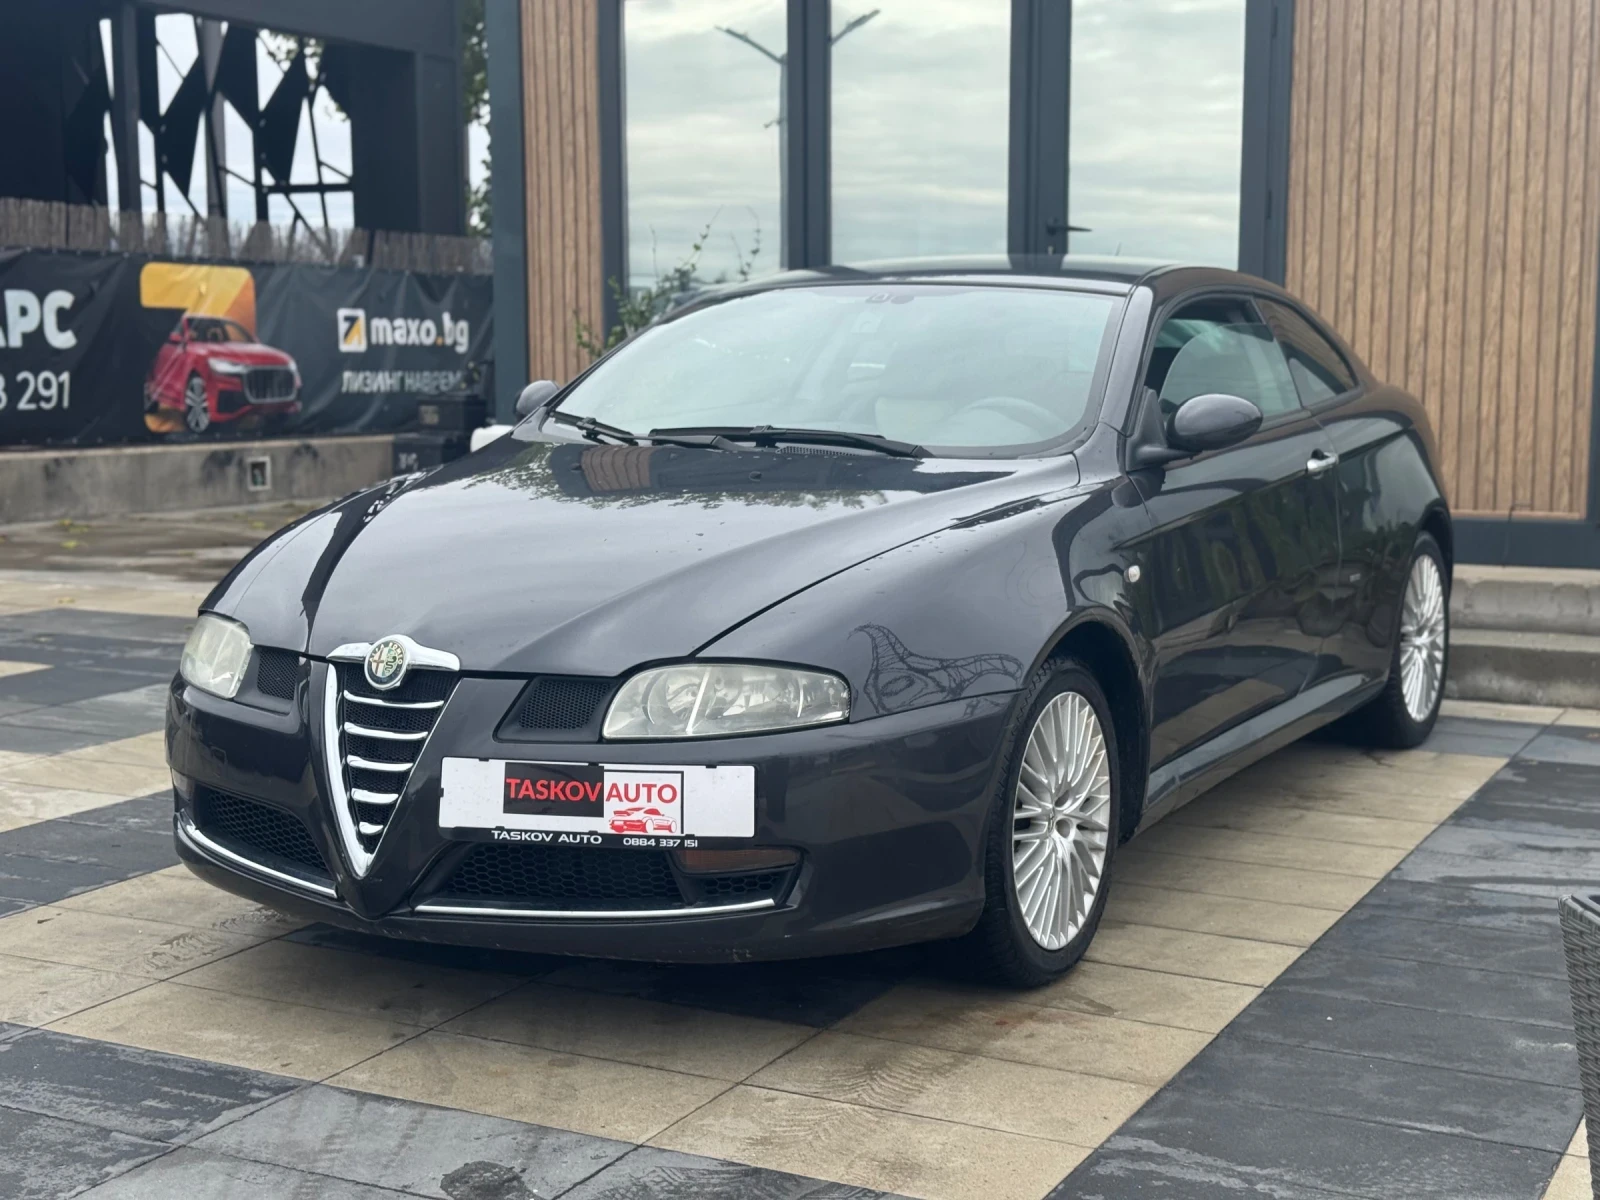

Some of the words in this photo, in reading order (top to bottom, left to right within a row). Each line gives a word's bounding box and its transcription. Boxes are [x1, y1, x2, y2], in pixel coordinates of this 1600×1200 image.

[0, 289, 78, 349] РС
[370, 311, 469, 354] maxo.bg
[16, 370, 71, 411] 291
[505, 777, 602, 803] TASKOV
[605, 782, 678, 804] AUTO
[491, 829, 554, 843] TASKOV
[558, 832, 603, 845] AUTO
[623, 837, 656, 847] 0884
[659, 838, 681, 848] 337
[684, 839, 698, 848] 151
